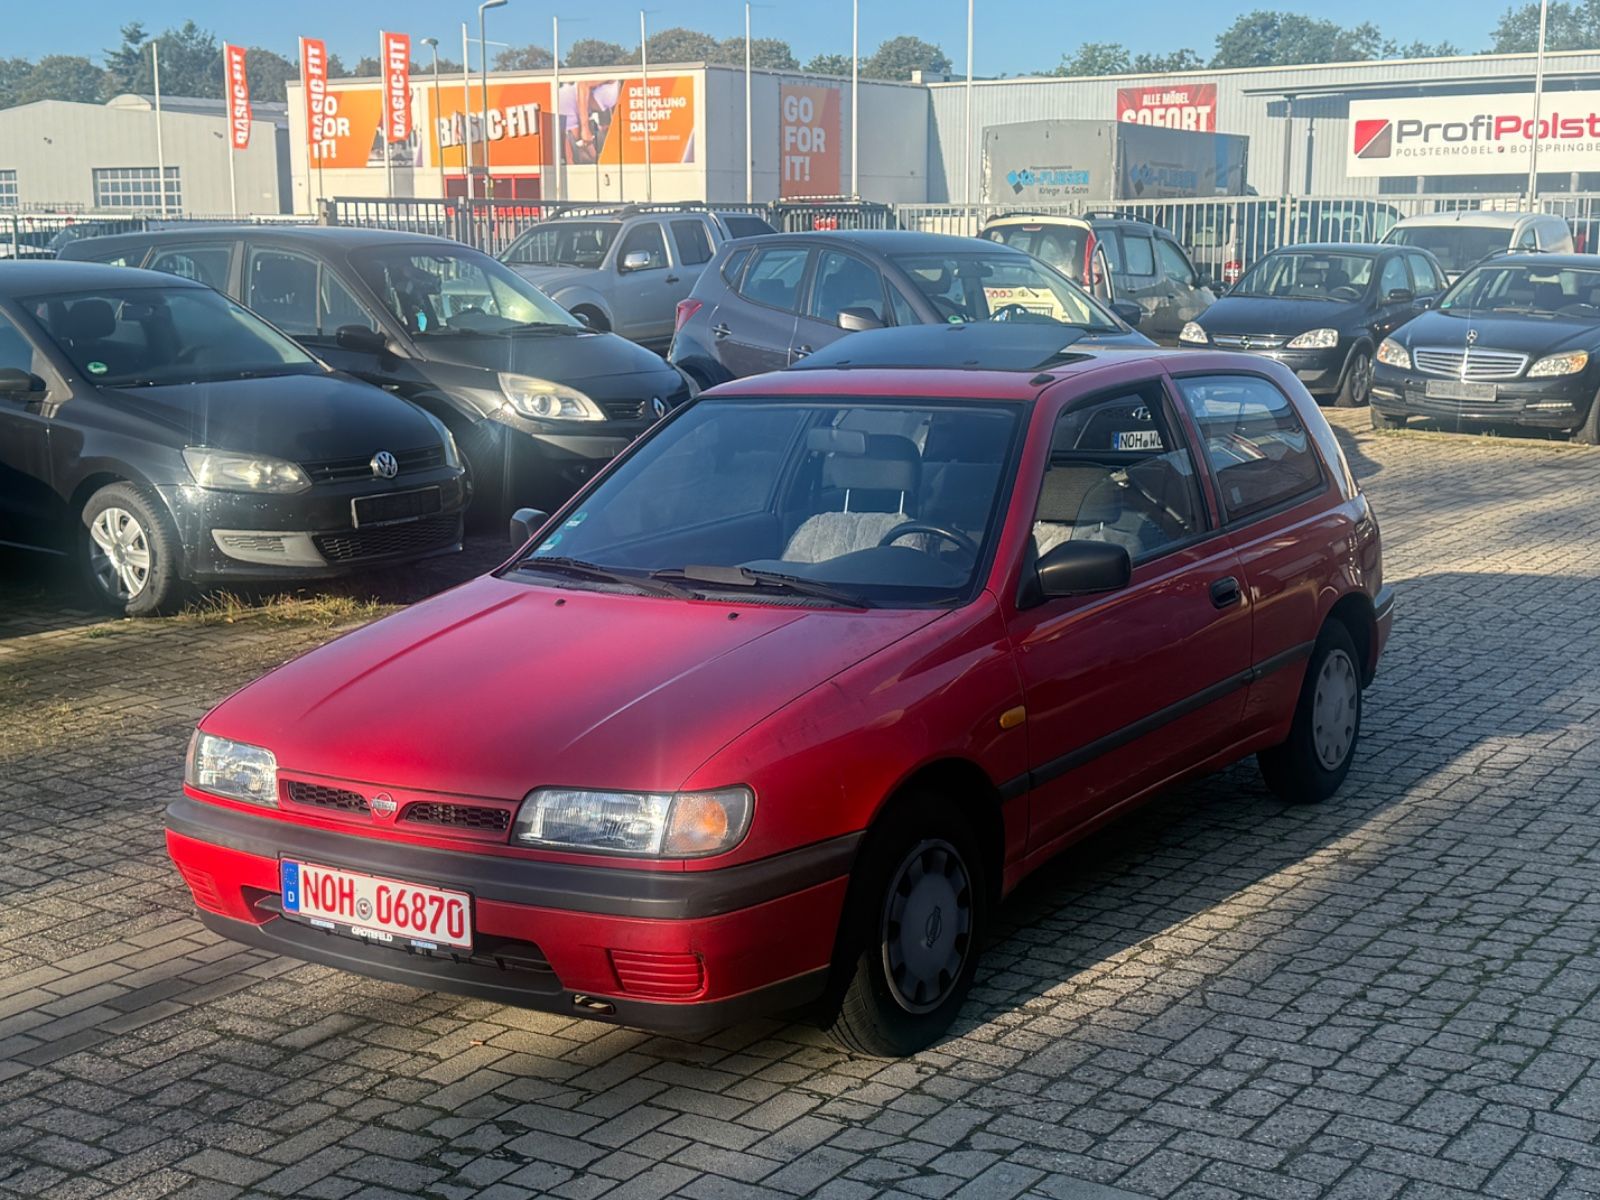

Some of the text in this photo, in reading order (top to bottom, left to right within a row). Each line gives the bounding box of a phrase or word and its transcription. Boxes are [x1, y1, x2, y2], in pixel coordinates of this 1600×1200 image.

[629, 86, 661, 97] DENE
[1142, 90, 1189, 106] ALLE MÖBEL
[324, 95, 337, 115] O
[783, 96, 814, 123] GO
[323, 116, 350, 137] OR
[630, 121, 658, 132] DAU
[1121, 105, 1211, 133] SOFORT
[313, 139, 336, 158] IT!
[785, 126, 826, 153] FOR
[1396, 145, 1493, 157] POLSTERMÖBEL
[785, 156, 811, 182] IT!
[1120, 434, 1143, 448] NOH
[288, 891, 295, 903] D
[302, 870, 464, 939] NOH 06870
